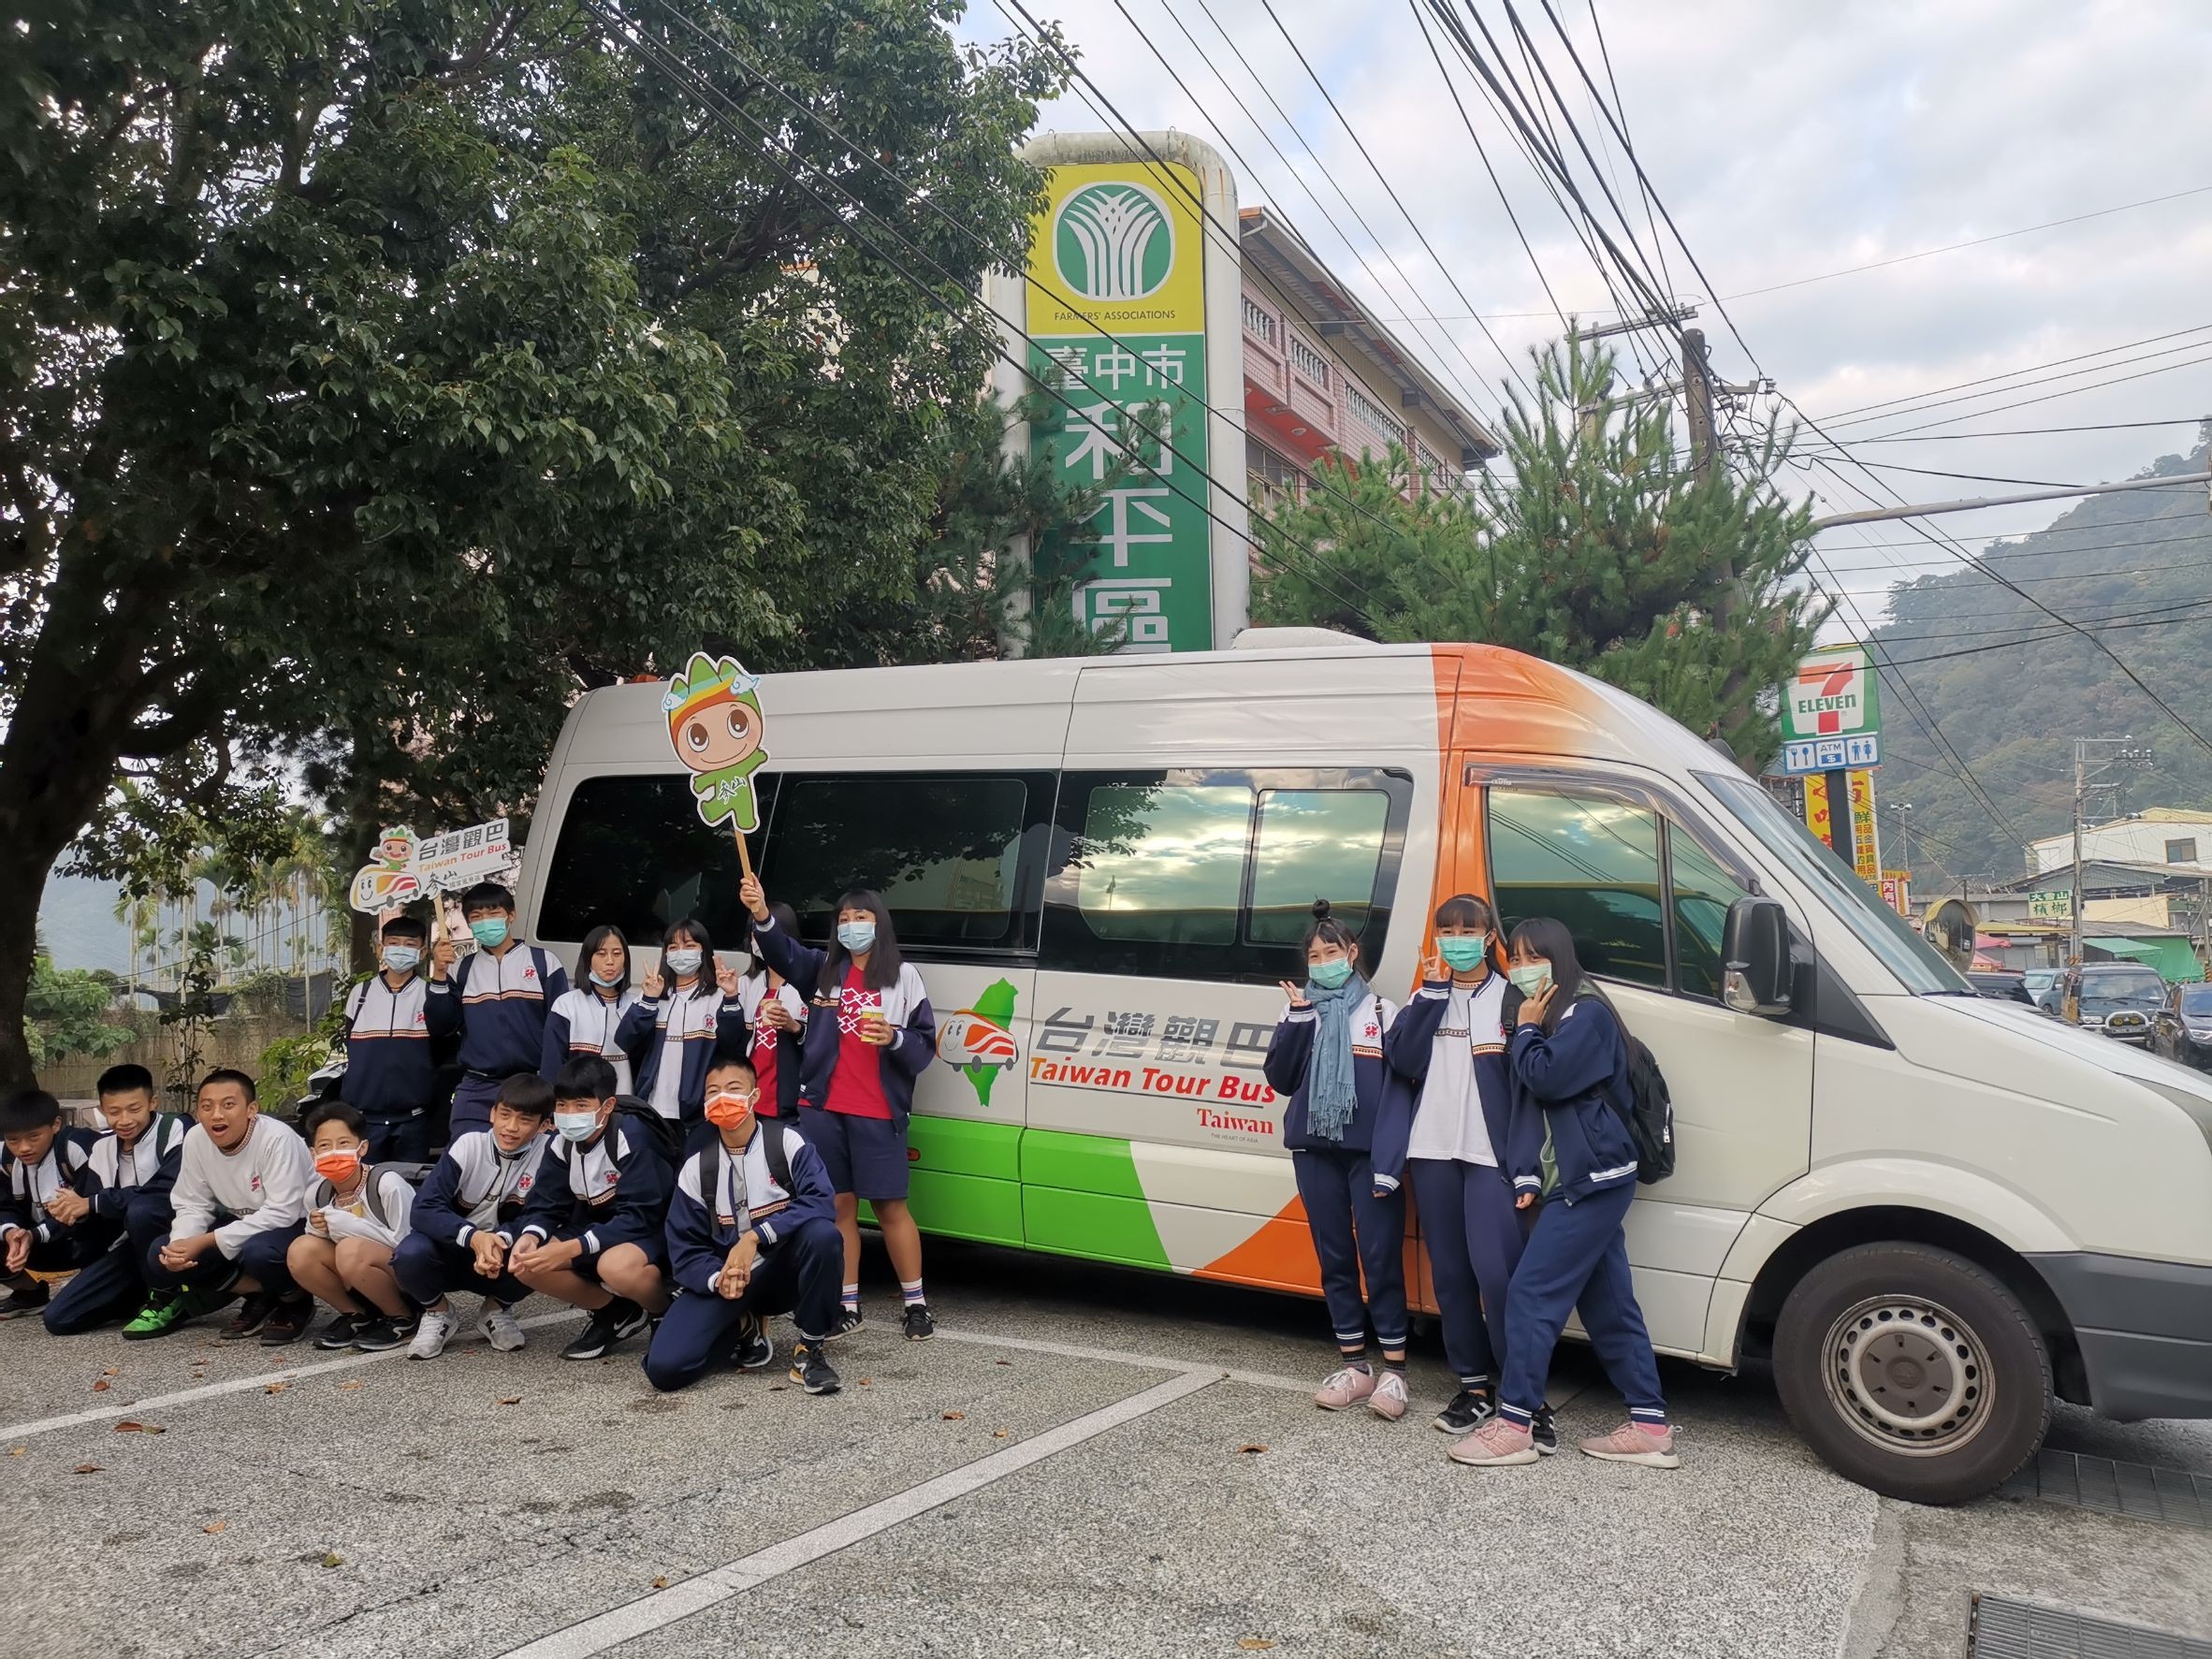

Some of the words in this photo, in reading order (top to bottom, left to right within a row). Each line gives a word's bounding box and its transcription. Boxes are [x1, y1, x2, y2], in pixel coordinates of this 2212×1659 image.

[1055, 312, 1101, 321] FARMERS'
[1104, 310, 1176, 321] ASSOCIATIONS
[1045, 343, 1186, 390] 臺中市
[1066, 400, 1173, 654] 和平區
[1820, 743, 1841, 752] ATM
[418, 857, 458, 873] Taiwan
[460, 850, 486, 862] Tour
[487, 843, 506, 854] Bus
[1030, 1056, 1132, 1088] Taiwan
[1142, 1068, 1212, 1096] Tour
[1217, 1075, 1275, 1103] Bus
[1197, 1108, 1273, 1135] Taiwan
